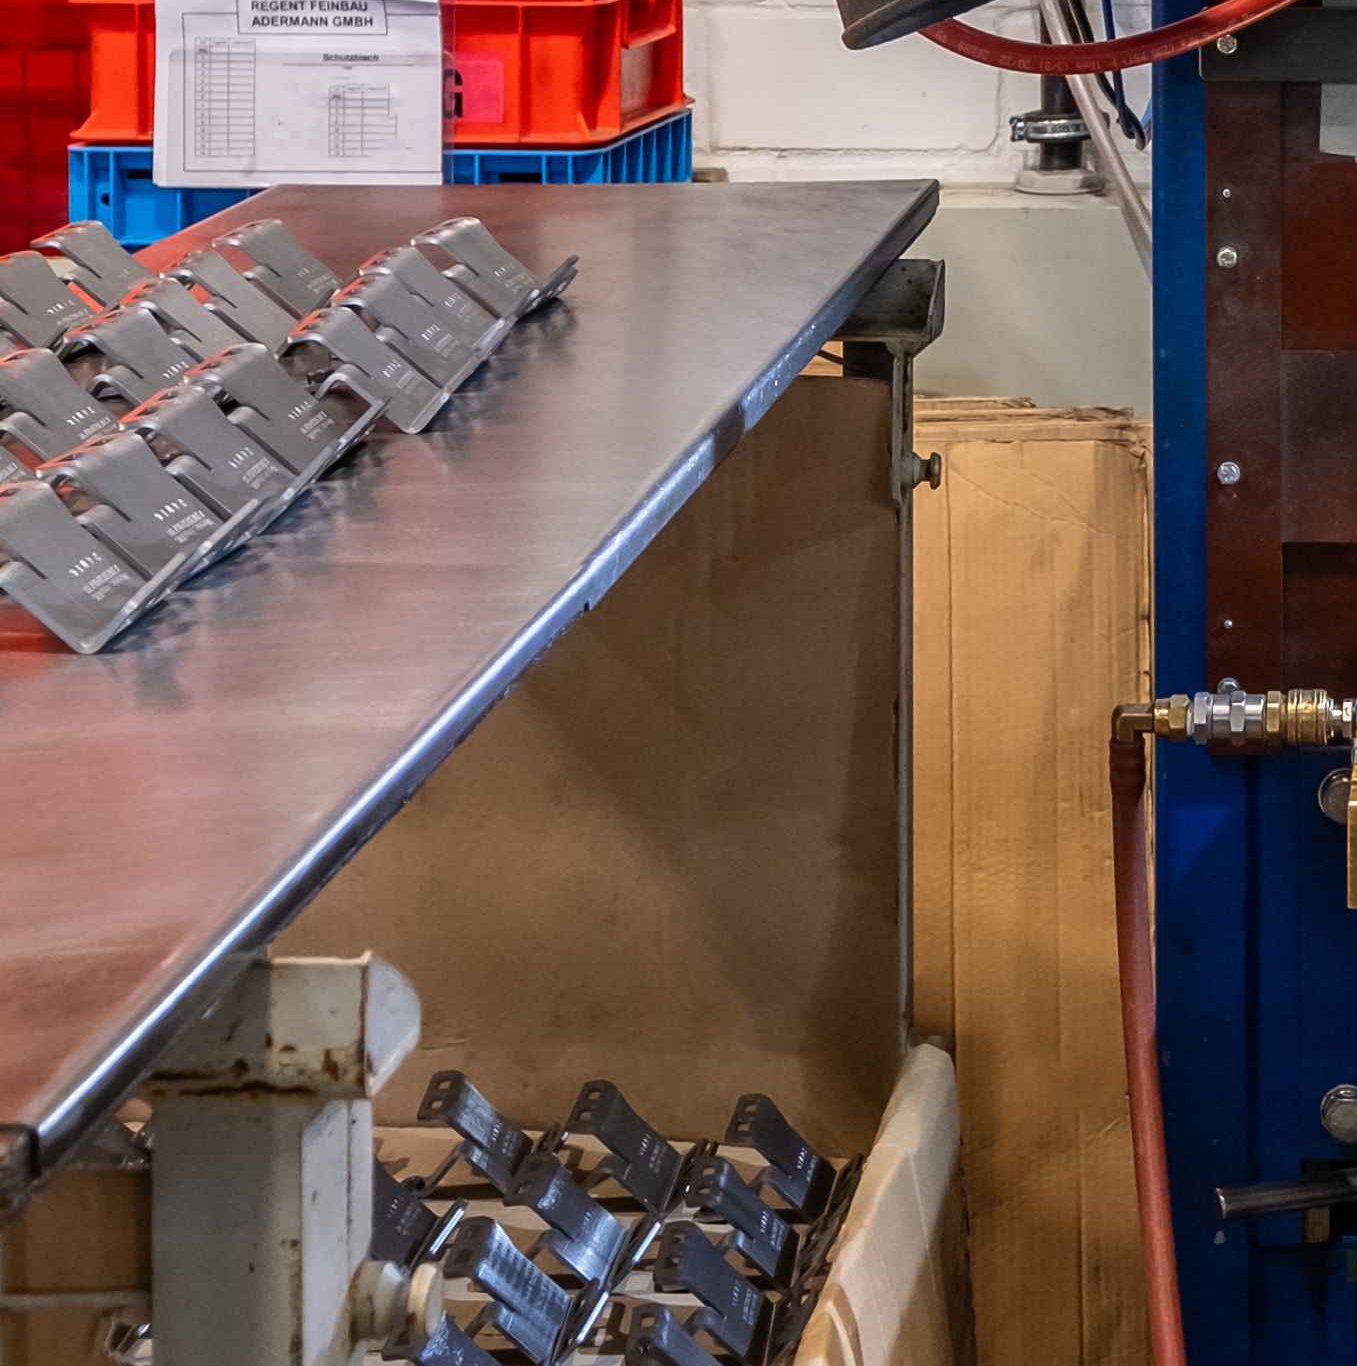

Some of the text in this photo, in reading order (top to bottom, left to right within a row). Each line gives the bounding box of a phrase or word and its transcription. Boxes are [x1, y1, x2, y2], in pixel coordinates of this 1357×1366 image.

[251, 0, 368, 12] REGENT FEINBAU
[251, 16, 374, 28] ADERMANN GMBH
[322, 53, 380, 62] Schutzblech
